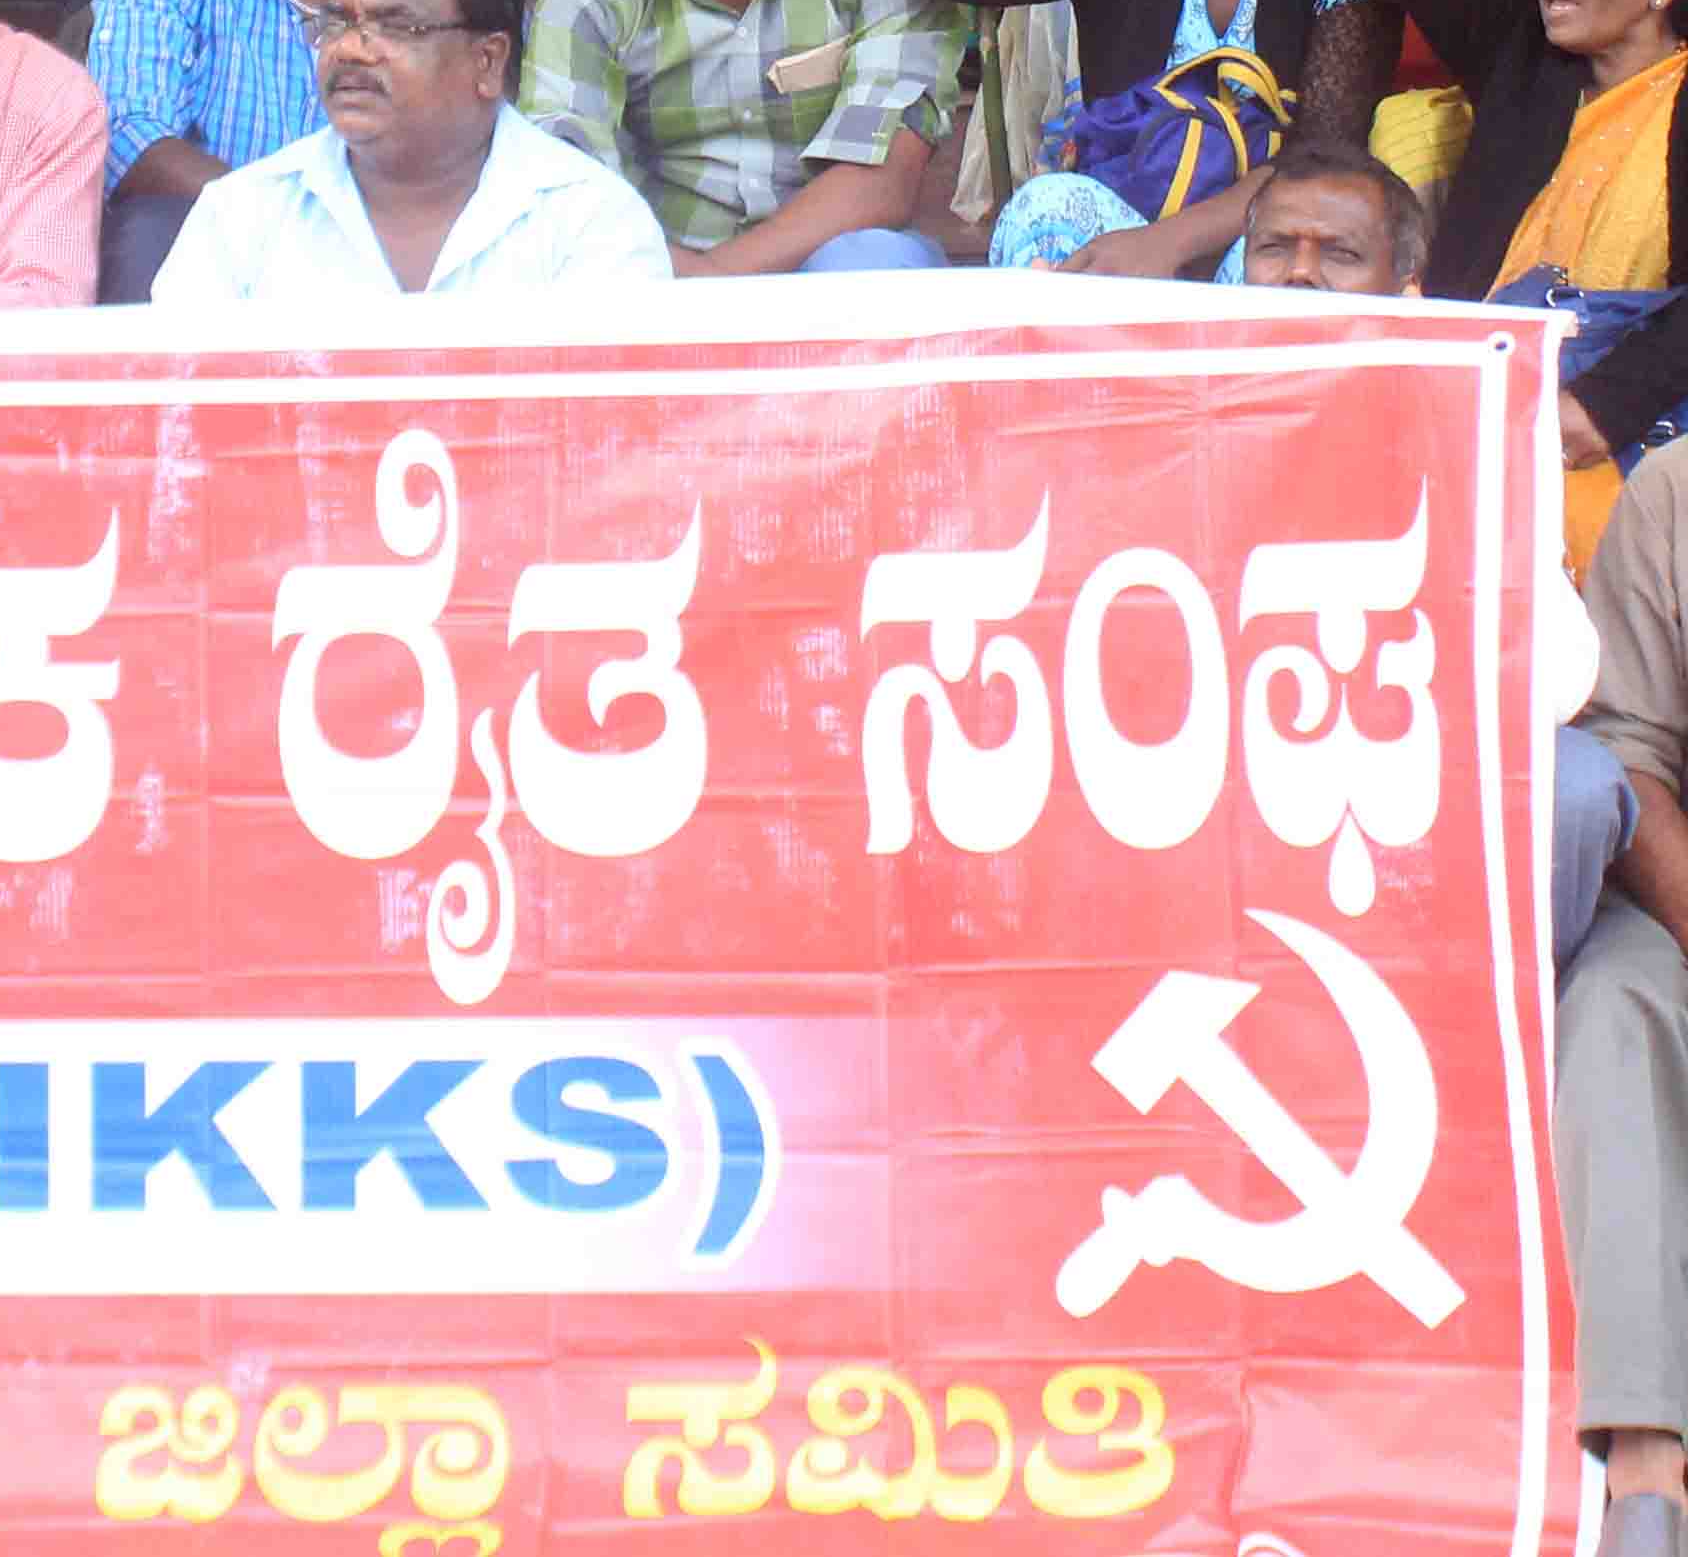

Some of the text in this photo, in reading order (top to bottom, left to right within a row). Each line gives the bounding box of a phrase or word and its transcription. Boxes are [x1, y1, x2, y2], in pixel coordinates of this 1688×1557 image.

[272, 429, 708, 1004] ರೈತ
[861, 473, 1441, 916] ಸಂಘ
[95, 1383, 514, 1557] ಜಿಲ್ಲಾ
[623, 1336, 1177, 1522] ಸಮಿತಿ
